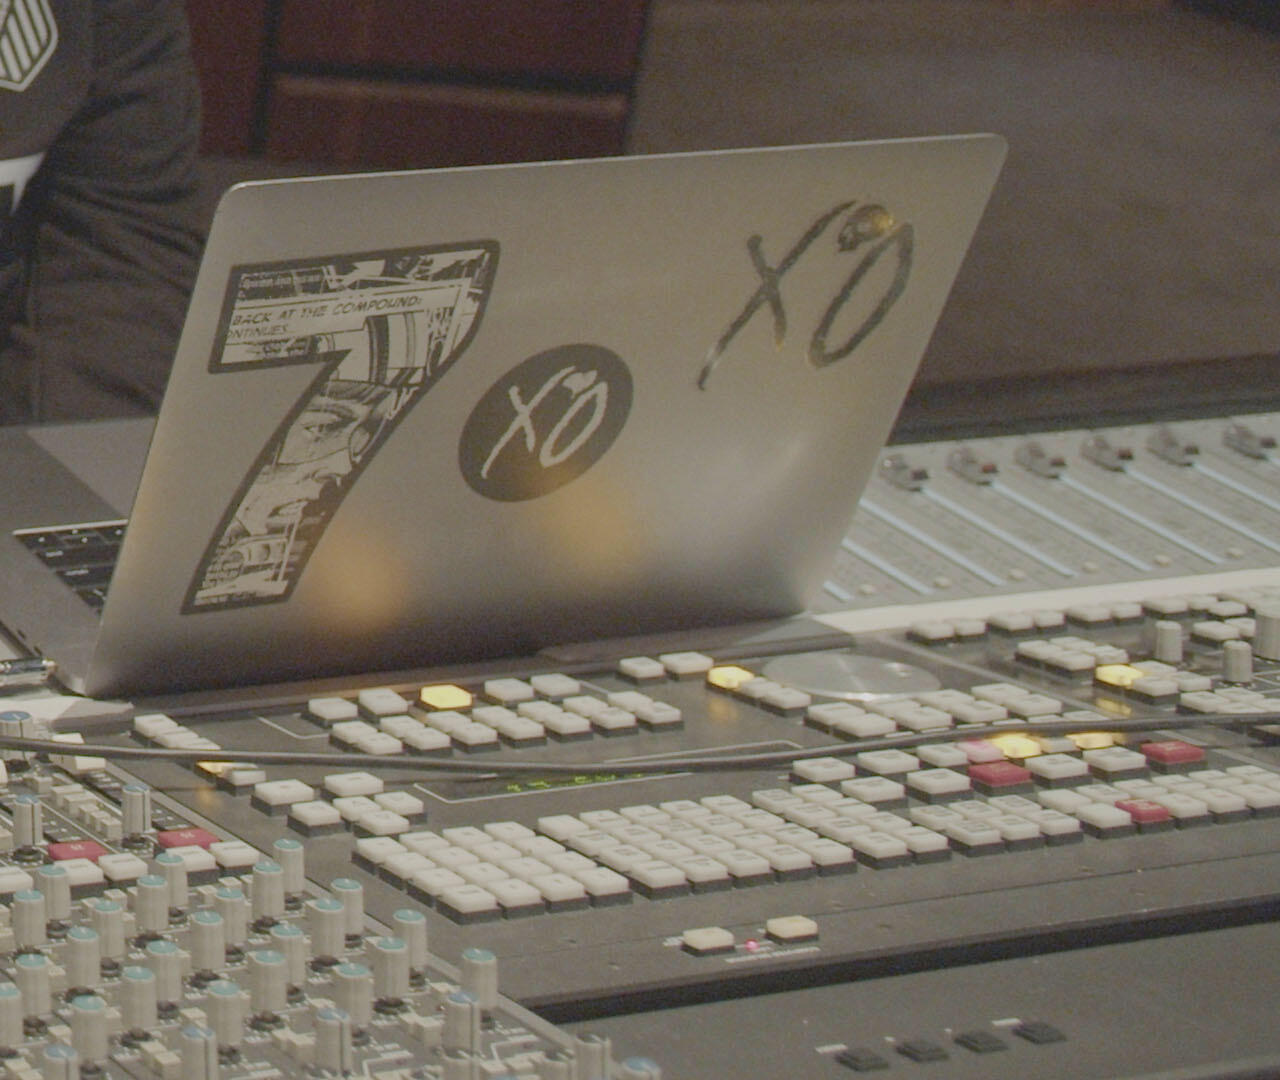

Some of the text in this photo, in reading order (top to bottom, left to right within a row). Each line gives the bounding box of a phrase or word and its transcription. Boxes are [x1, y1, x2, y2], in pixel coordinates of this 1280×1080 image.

[231, 311, 273, 326] BACK
[279, 308, 297, 320] AT
[300, 305, 329, 319] THE
